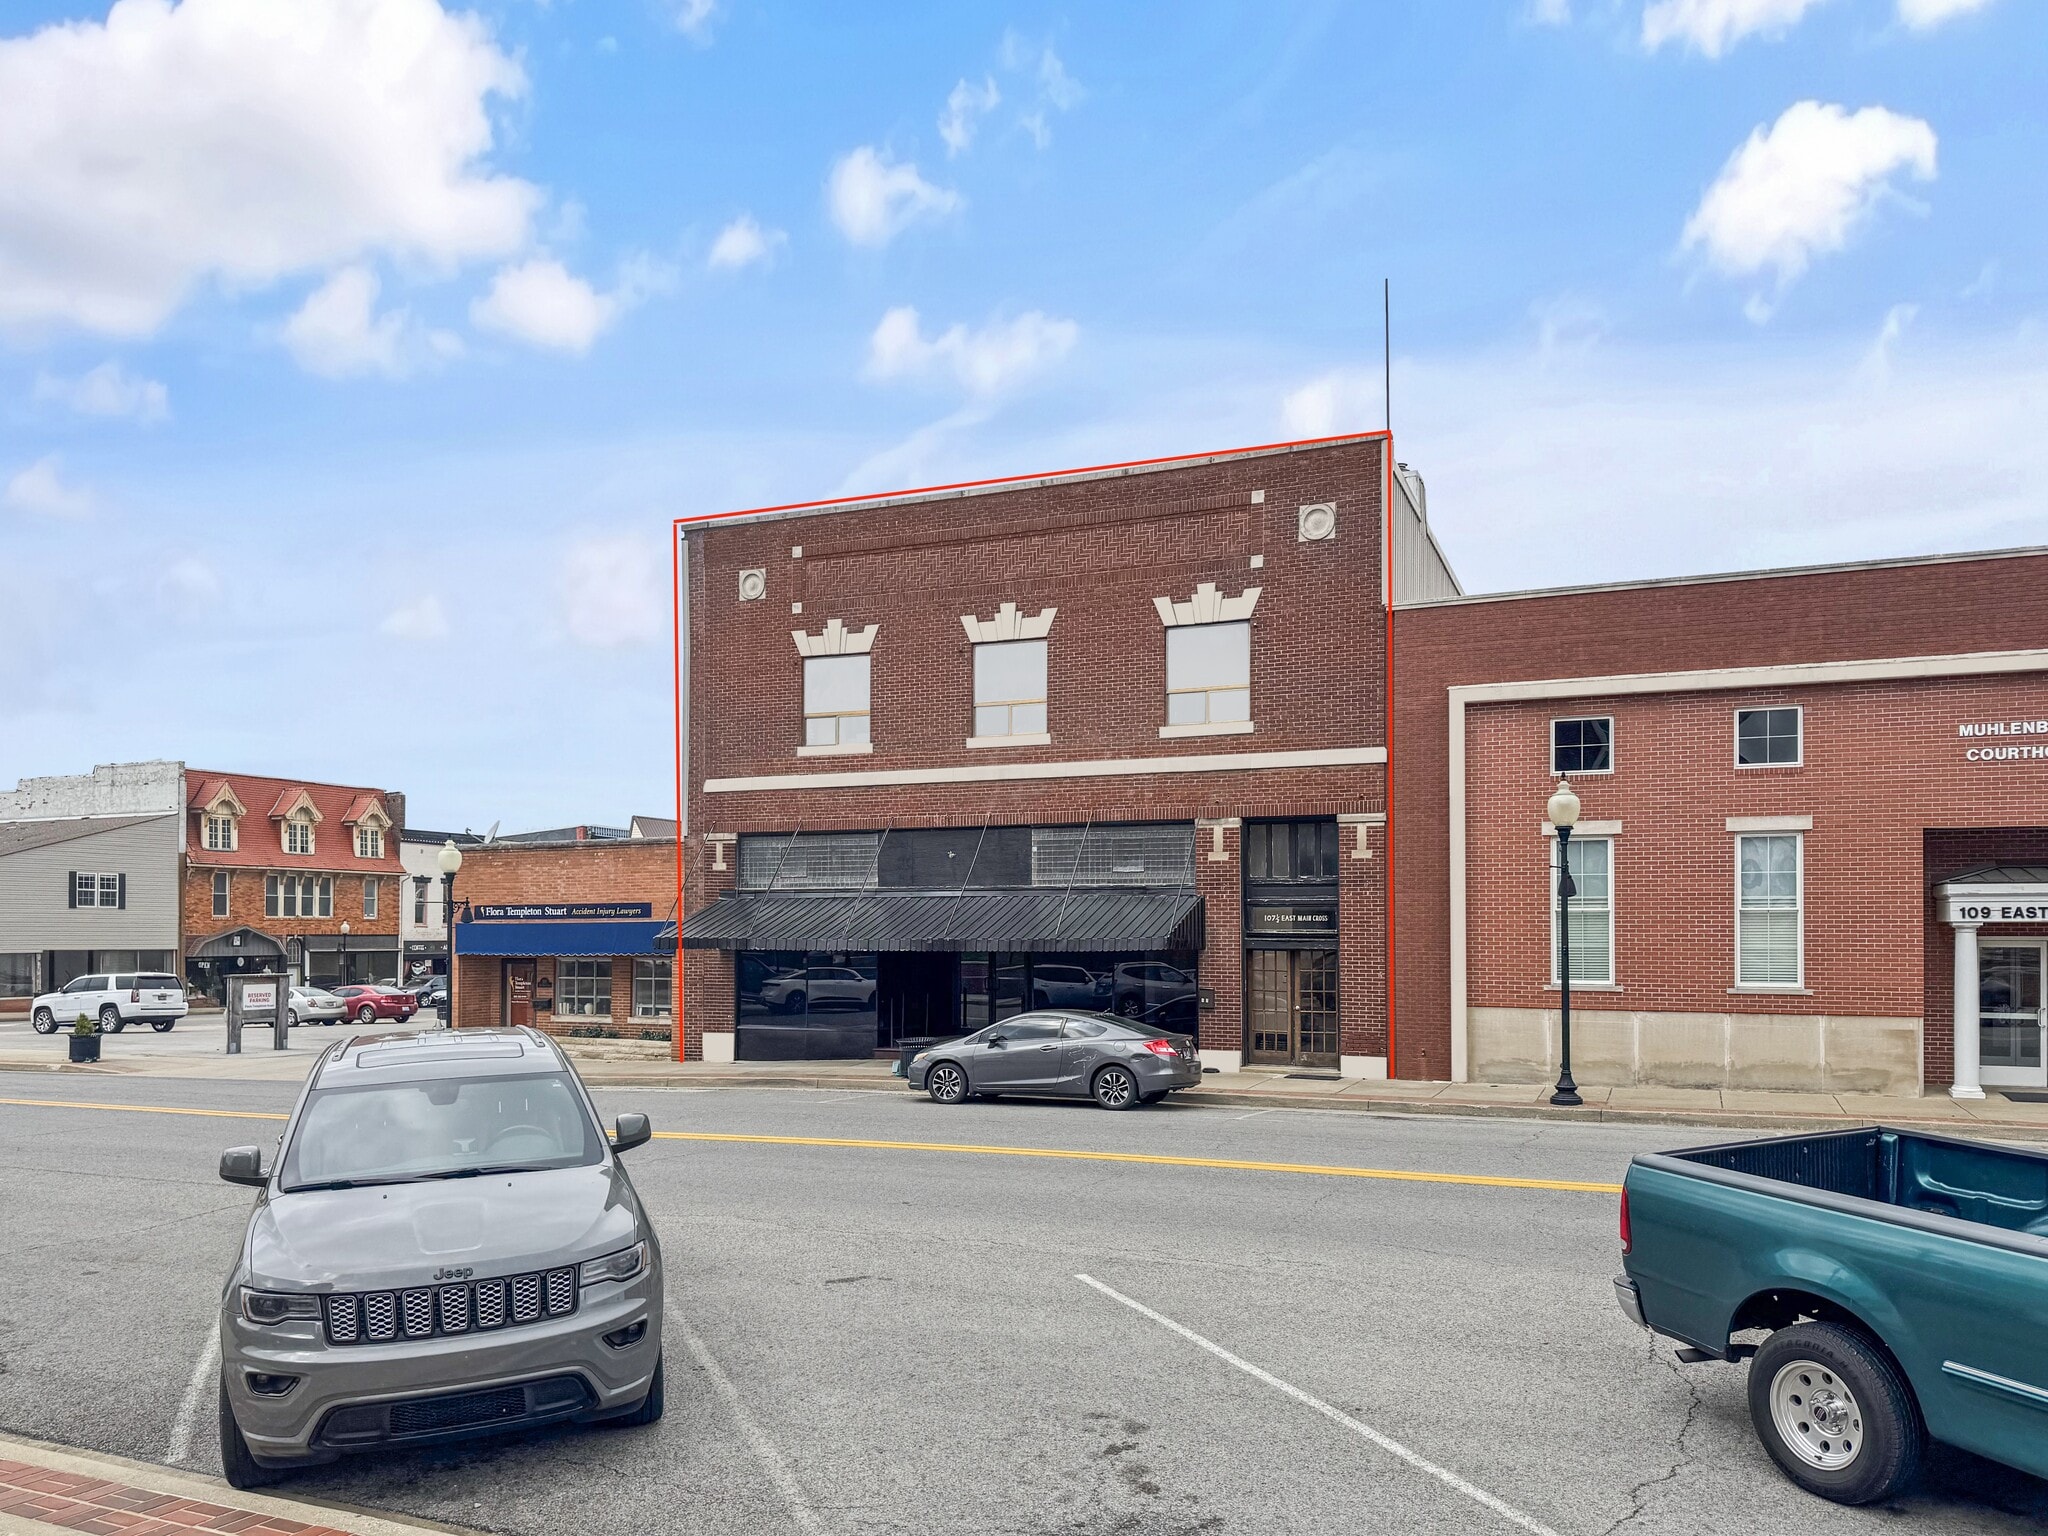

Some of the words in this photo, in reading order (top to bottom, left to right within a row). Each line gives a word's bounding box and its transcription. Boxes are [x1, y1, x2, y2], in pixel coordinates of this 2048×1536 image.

[1966, 746, 2048, 761] COURTH
[486, 907, 504, 916] Flora
[506, 907, 542, 918] Templeton
[544, 907, 567, 915] Stuart
[597, 907, 615, 916] Injury
[617, 907, 641, 916] Lawyers
[1959, 906, 1991, 919] 109
[2001, 906, 2048, 919] EAST
[433, 1266, 474, 1281] Jeep
